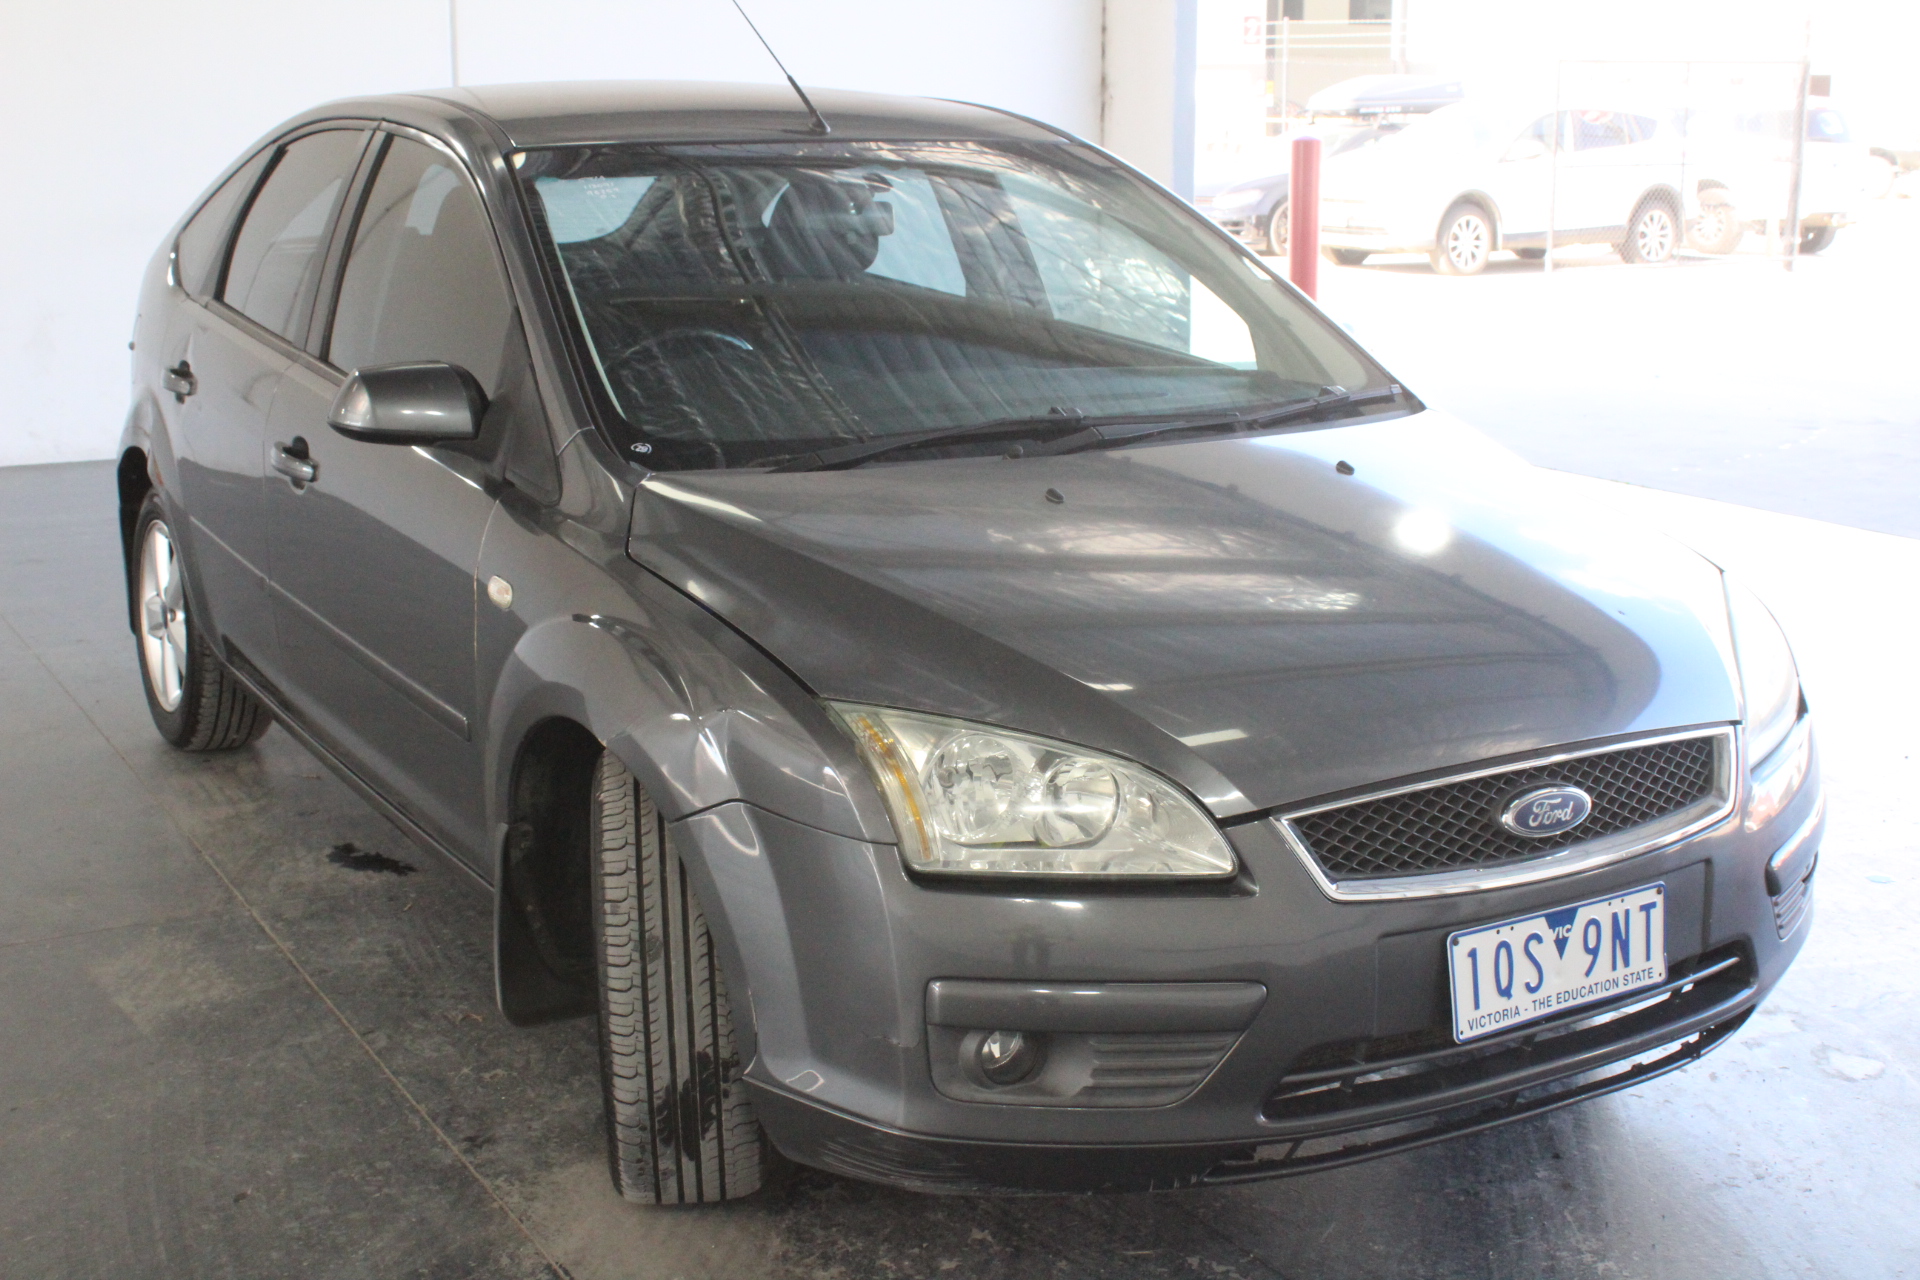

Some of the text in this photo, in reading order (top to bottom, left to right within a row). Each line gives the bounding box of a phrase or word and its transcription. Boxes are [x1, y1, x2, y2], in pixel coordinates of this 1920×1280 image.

[1529, 797, 1574, 827] Ford
[1467, 901, 1657, 1011] 1QS 9NT
[1550, 924, 1572, 941] VIC
[1467, 1005, 1521, 1031] VICTORIA
[1531, 994, 1553, 1012] THE
[1556, 978, 1620, 1005] EDUCATION
[1622, 967, 1654, 987] STATE
